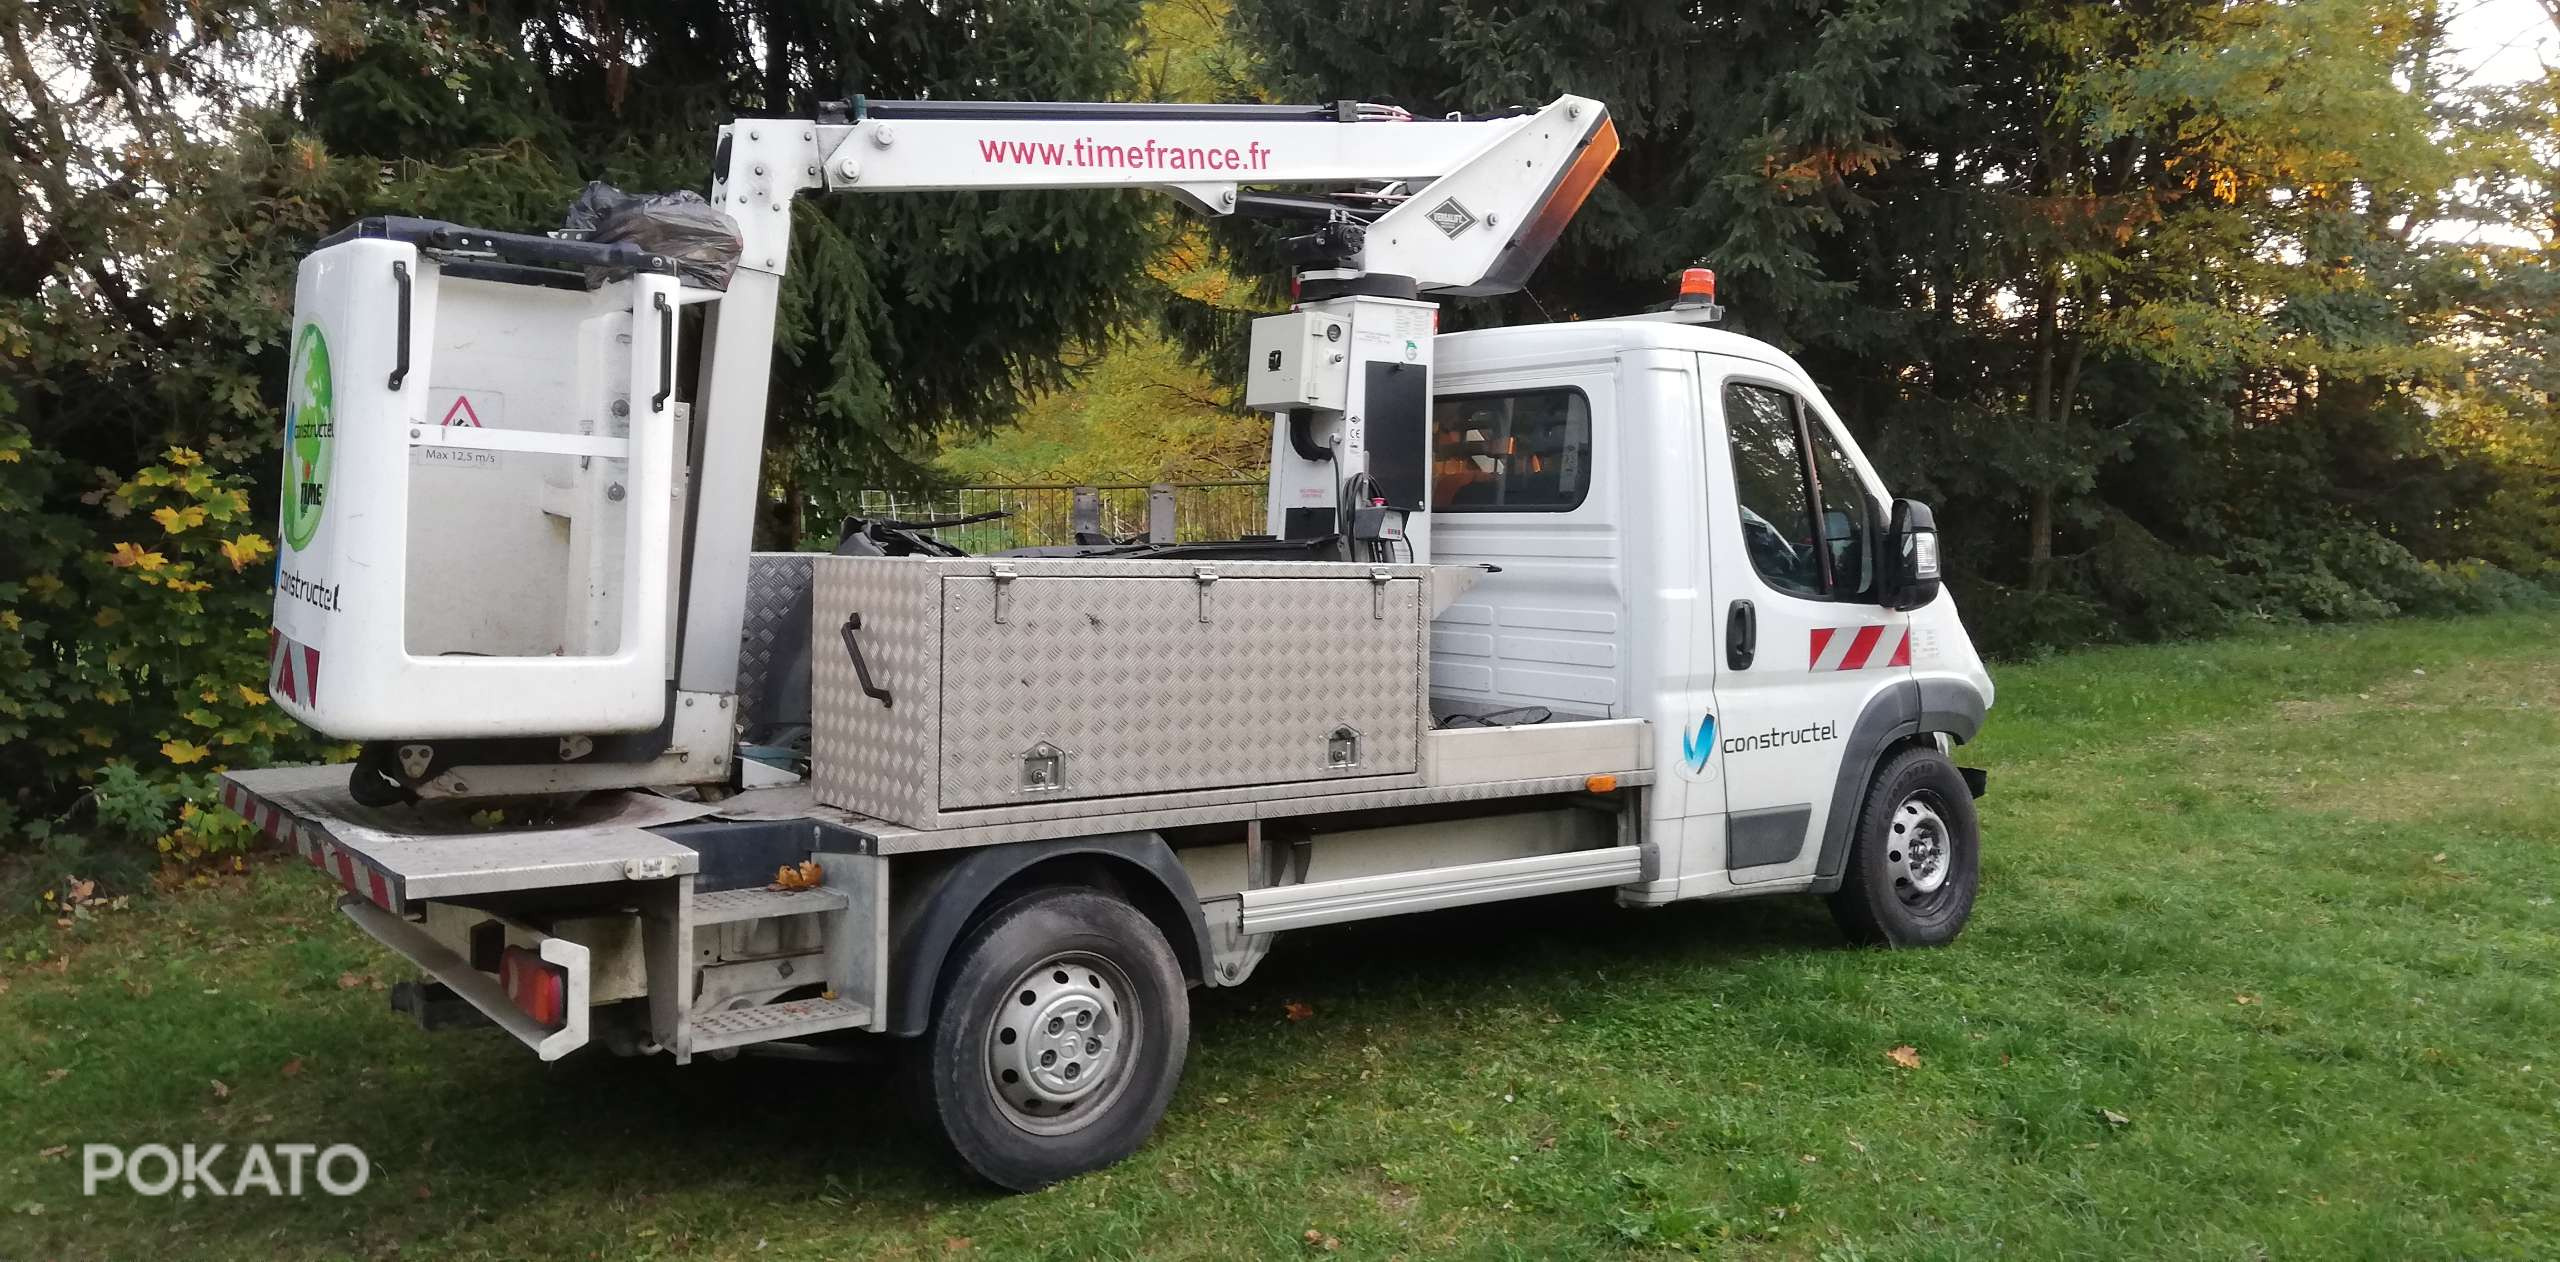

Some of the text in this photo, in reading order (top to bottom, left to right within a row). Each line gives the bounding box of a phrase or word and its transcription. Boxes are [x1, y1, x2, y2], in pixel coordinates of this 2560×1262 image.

[978, 137, 1271, 170] www.timefrance.fr
[425, 449, 448, 460] Max
[475, 453, 496, 463] m/s
[1723, 719, 1838, 754] constructel
